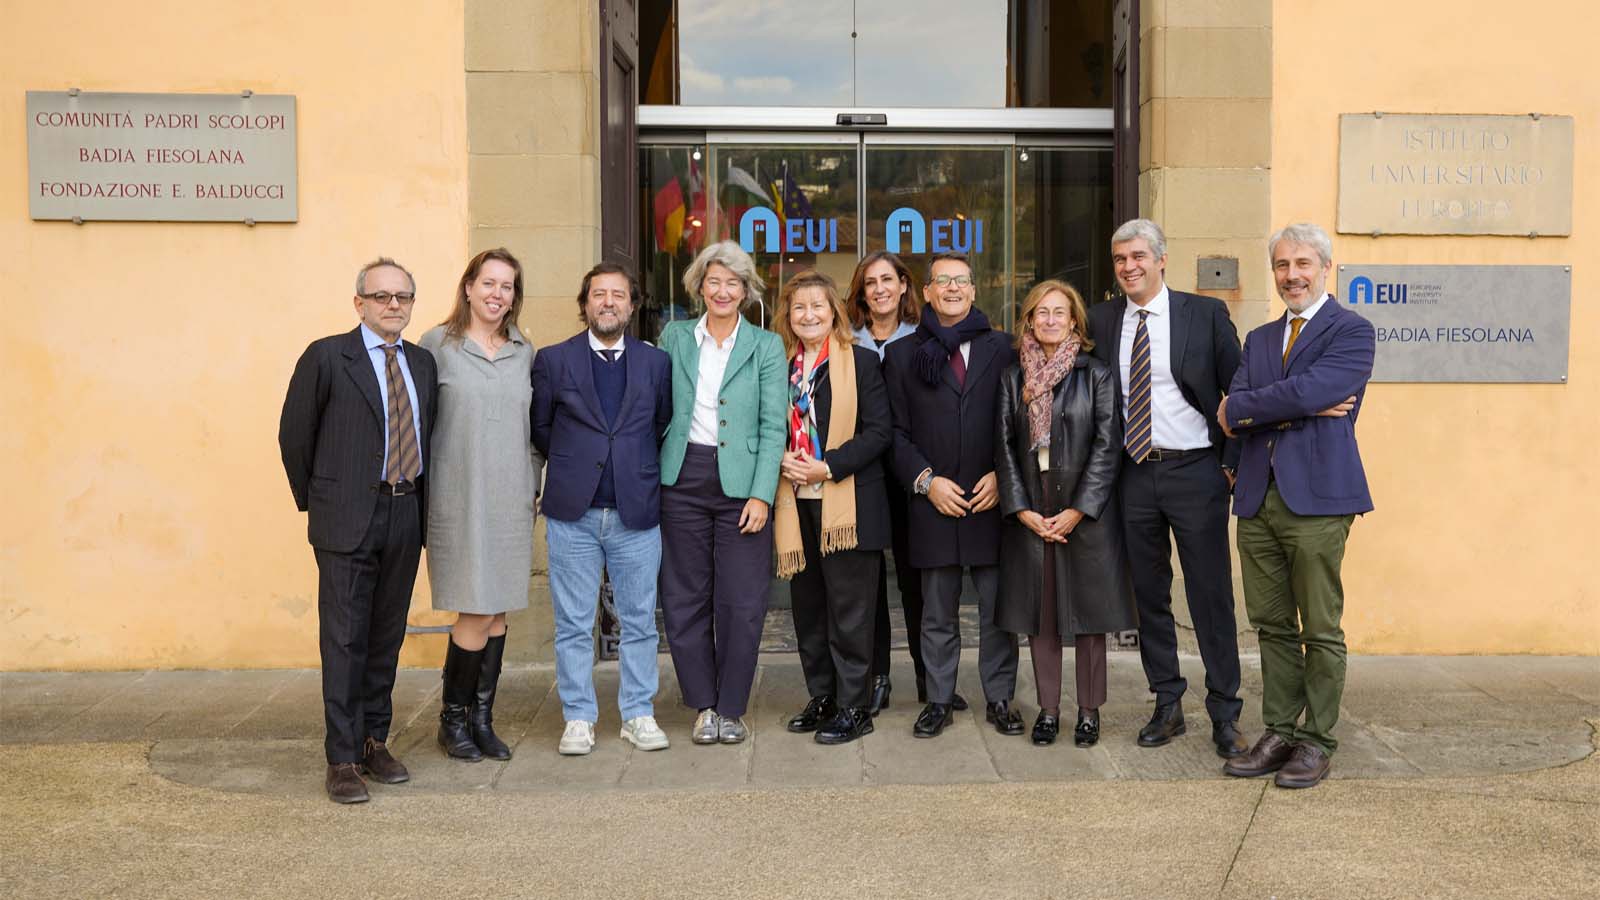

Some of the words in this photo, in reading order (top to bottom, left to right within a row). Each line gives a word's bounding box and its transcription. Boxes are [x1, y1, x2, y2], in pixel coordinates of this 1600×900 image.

[145, 114, 198, 129] PADRI
[208, 115, 285, 130] SCOLOPI
[79, 148, 136, 163] BADIA
[147, 149, 245, 164] FIESOLANA
[40, 182, 162, 198] FONDAZIONE
[172, 184, 186, 198] E.
[196, 184, 284, 199] BALDUCCI
[786, 219, 837, 253] EUI
[932, 219, 983, 254] EUI
[1376, 284, 1407, 304] EUI
[1377, 328, 1430, 342] BADIA
[1436, 328, 1534, 342] FIESOLANA
